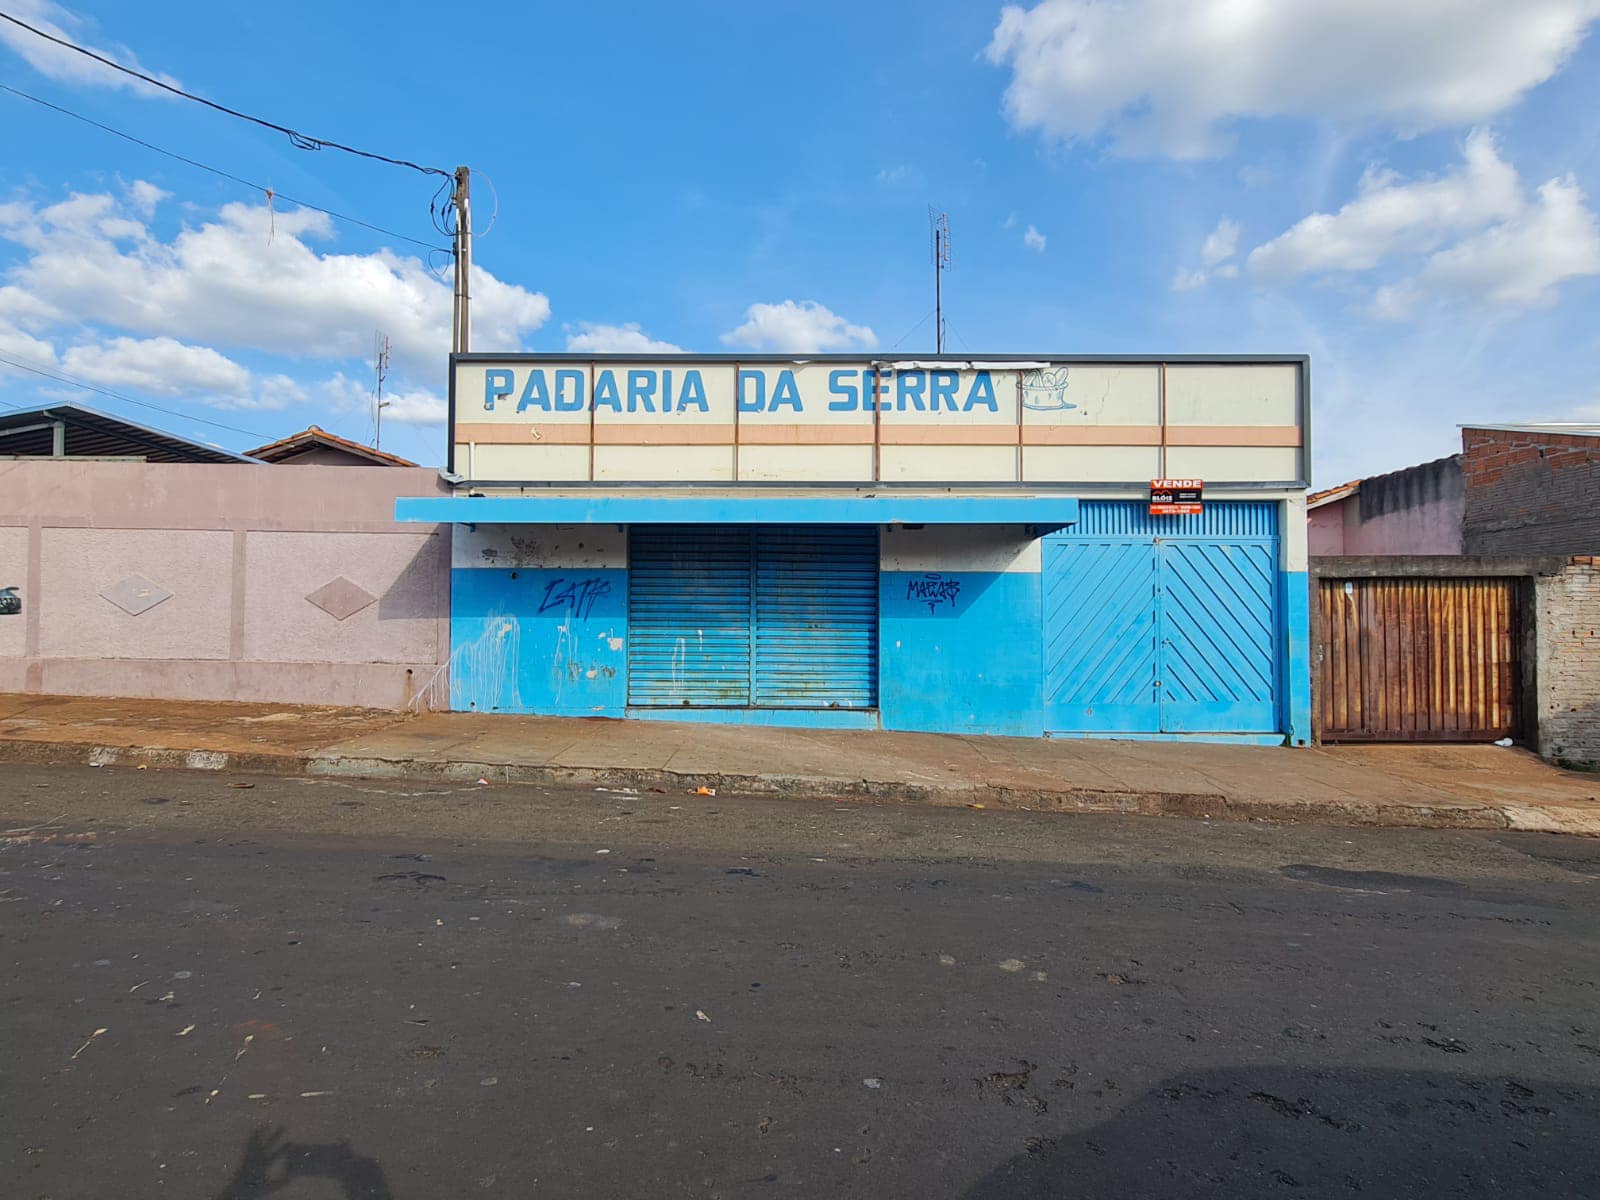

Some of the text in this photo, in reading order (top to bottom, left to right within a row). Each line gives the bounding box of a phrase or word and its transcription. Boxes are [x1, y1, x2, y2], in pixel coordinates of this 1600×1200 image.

[485, 368, 999, 413] PADARIA DA SERRA
[1153, 480, 1202, 489] VENDE
